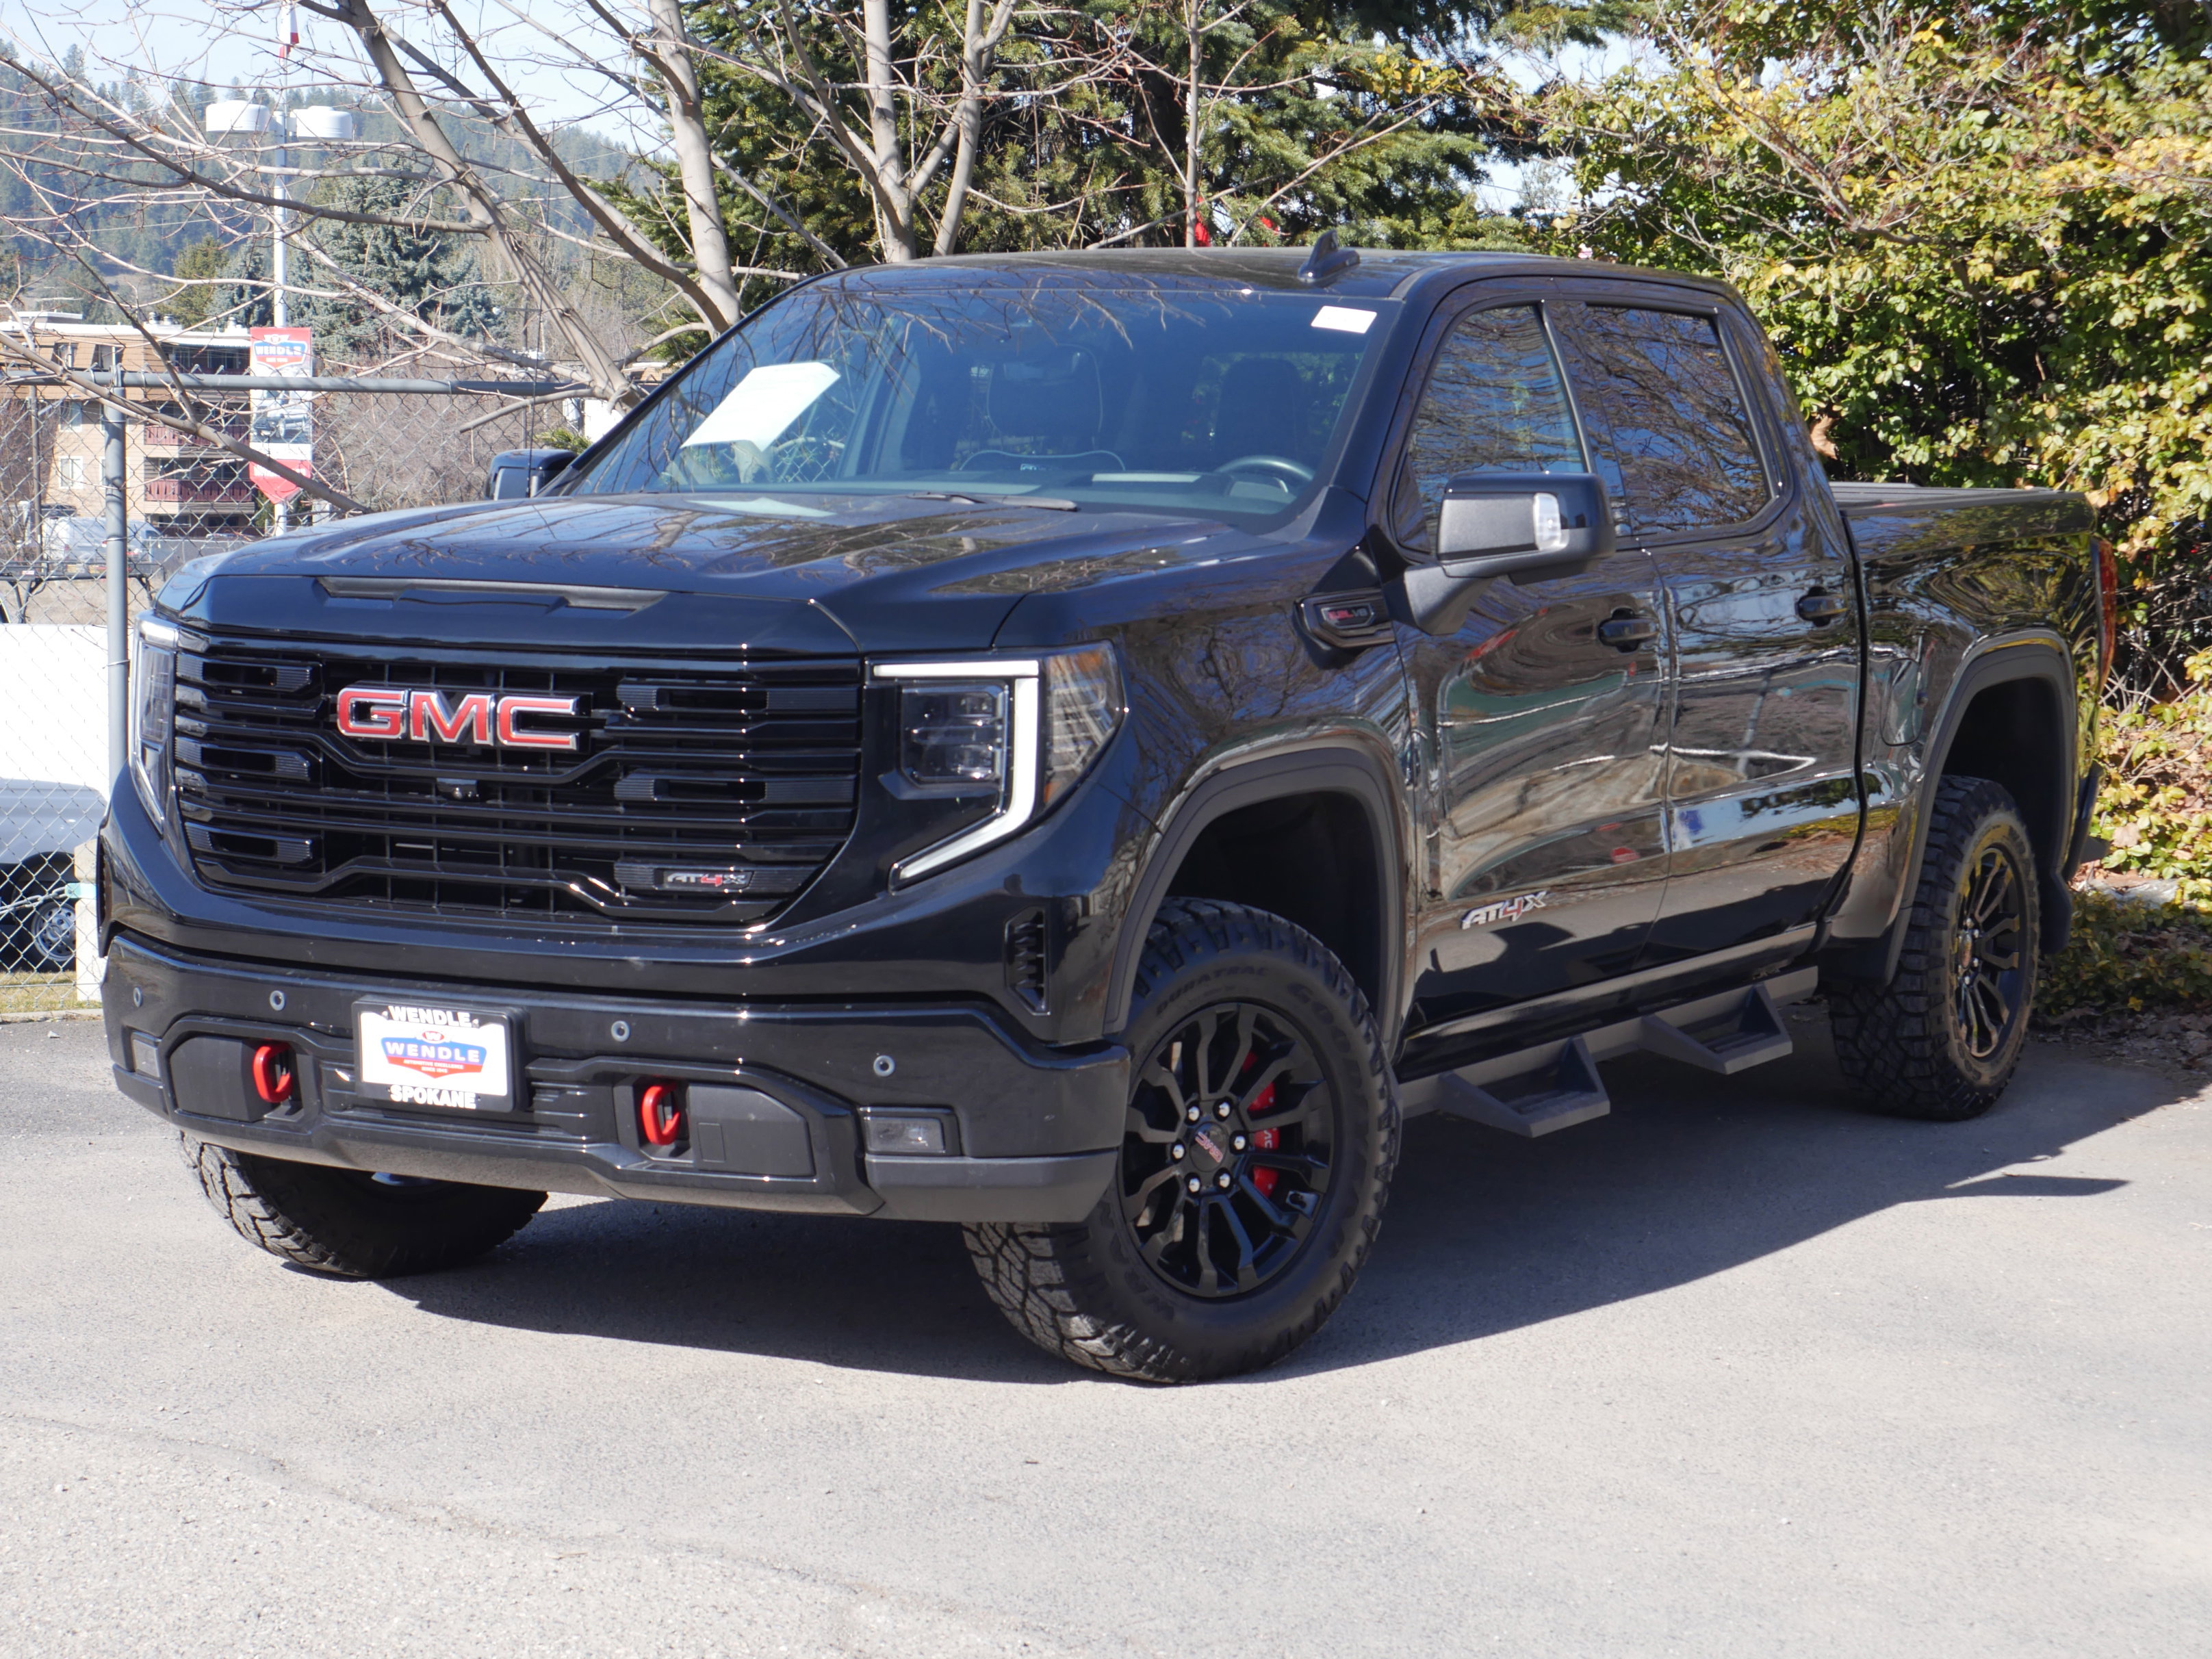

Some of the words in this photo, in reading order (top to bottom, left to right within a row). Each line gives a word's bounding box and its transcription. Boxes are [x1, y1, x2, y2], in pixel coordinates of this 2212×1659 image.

[255, 346, 302, 355] WENDLE
[337, 687, 581, 751] GMC
[667, 872, 746, 887] AT4X
[1461, 890, 1547, 930] AT4X
[388, 1005, 472, 1027] WENDLE
[385, 1041, 480, 1062] WENDLE
[389, 1084, 476, 1109] SPOKANE
[1195, 1131, 1223, 1163] GMC
